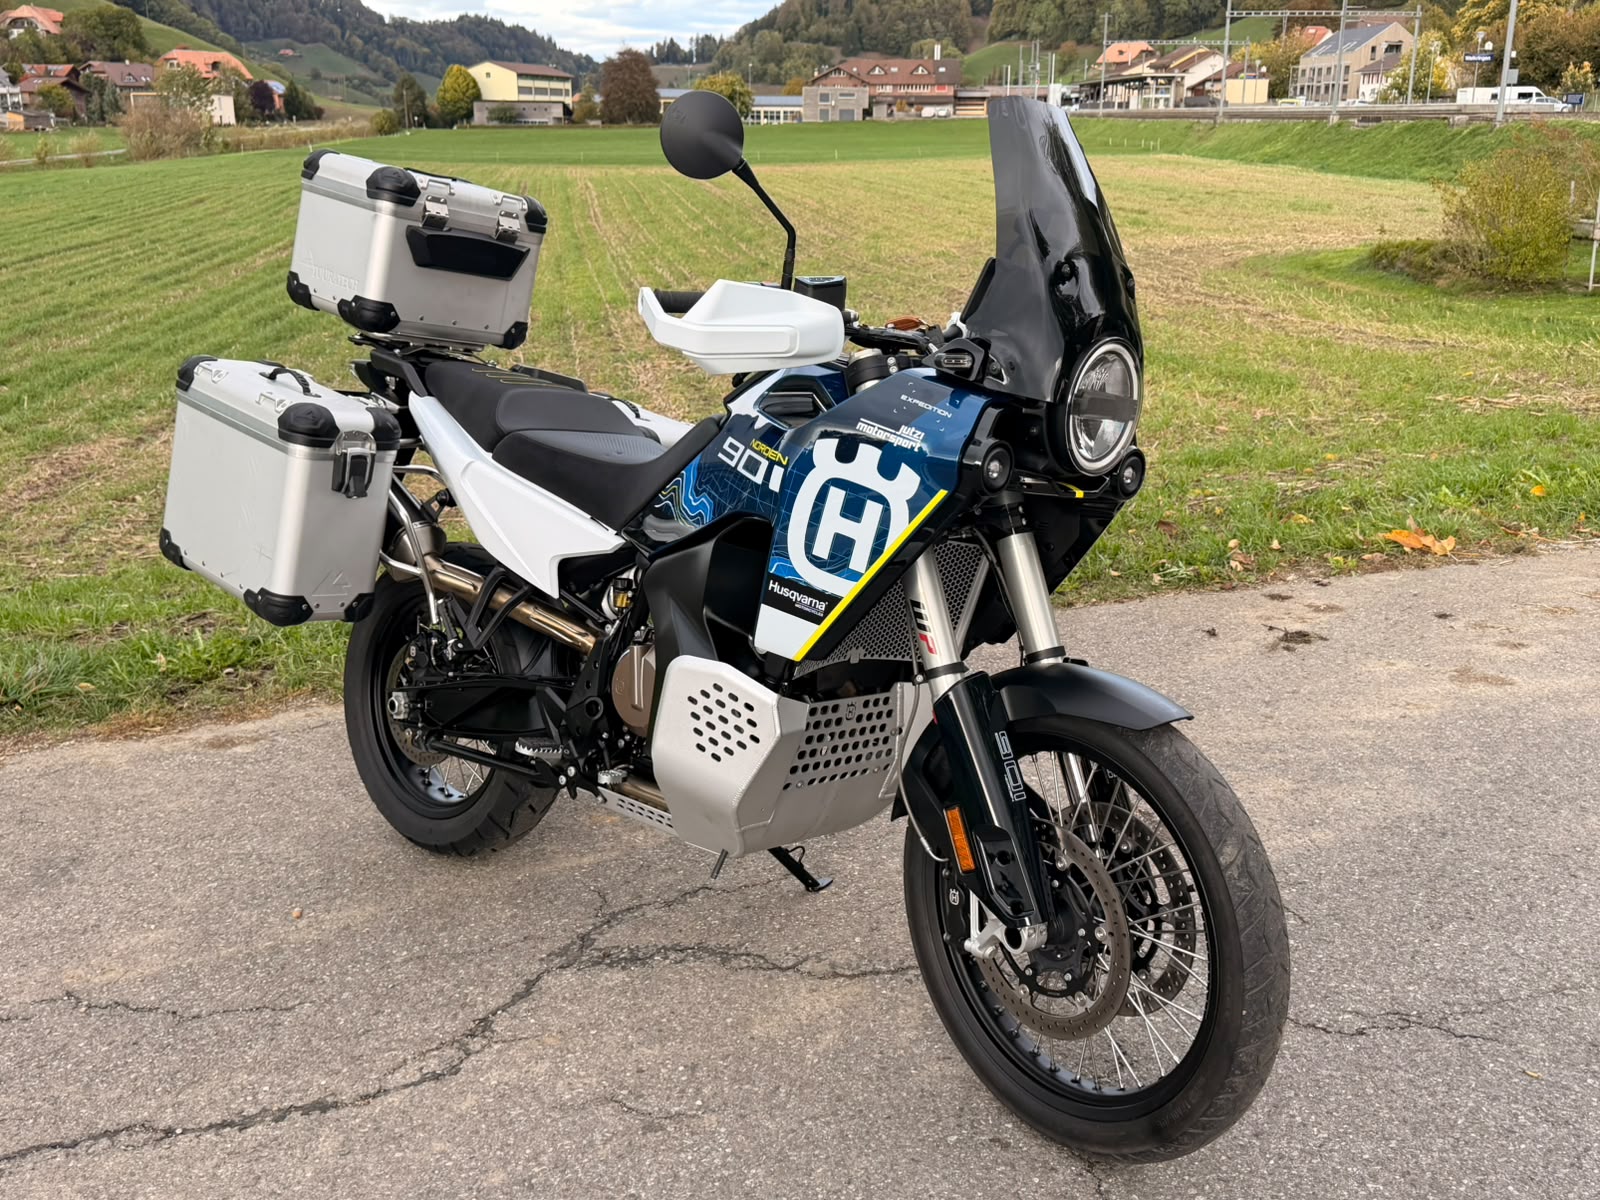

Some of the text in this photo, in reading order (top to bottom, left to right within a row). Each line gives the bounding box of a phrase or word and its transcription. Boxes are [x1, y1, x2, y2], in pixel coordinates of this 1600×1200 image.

[900, 393, 953, 418] EXPEDITION
[750, 438, 789, 466] NORDEN
[856, 421, 922, 453] motorsport
[717, 435, 785, 494] 901
[768, 579, 827, 611] Husqvarna
